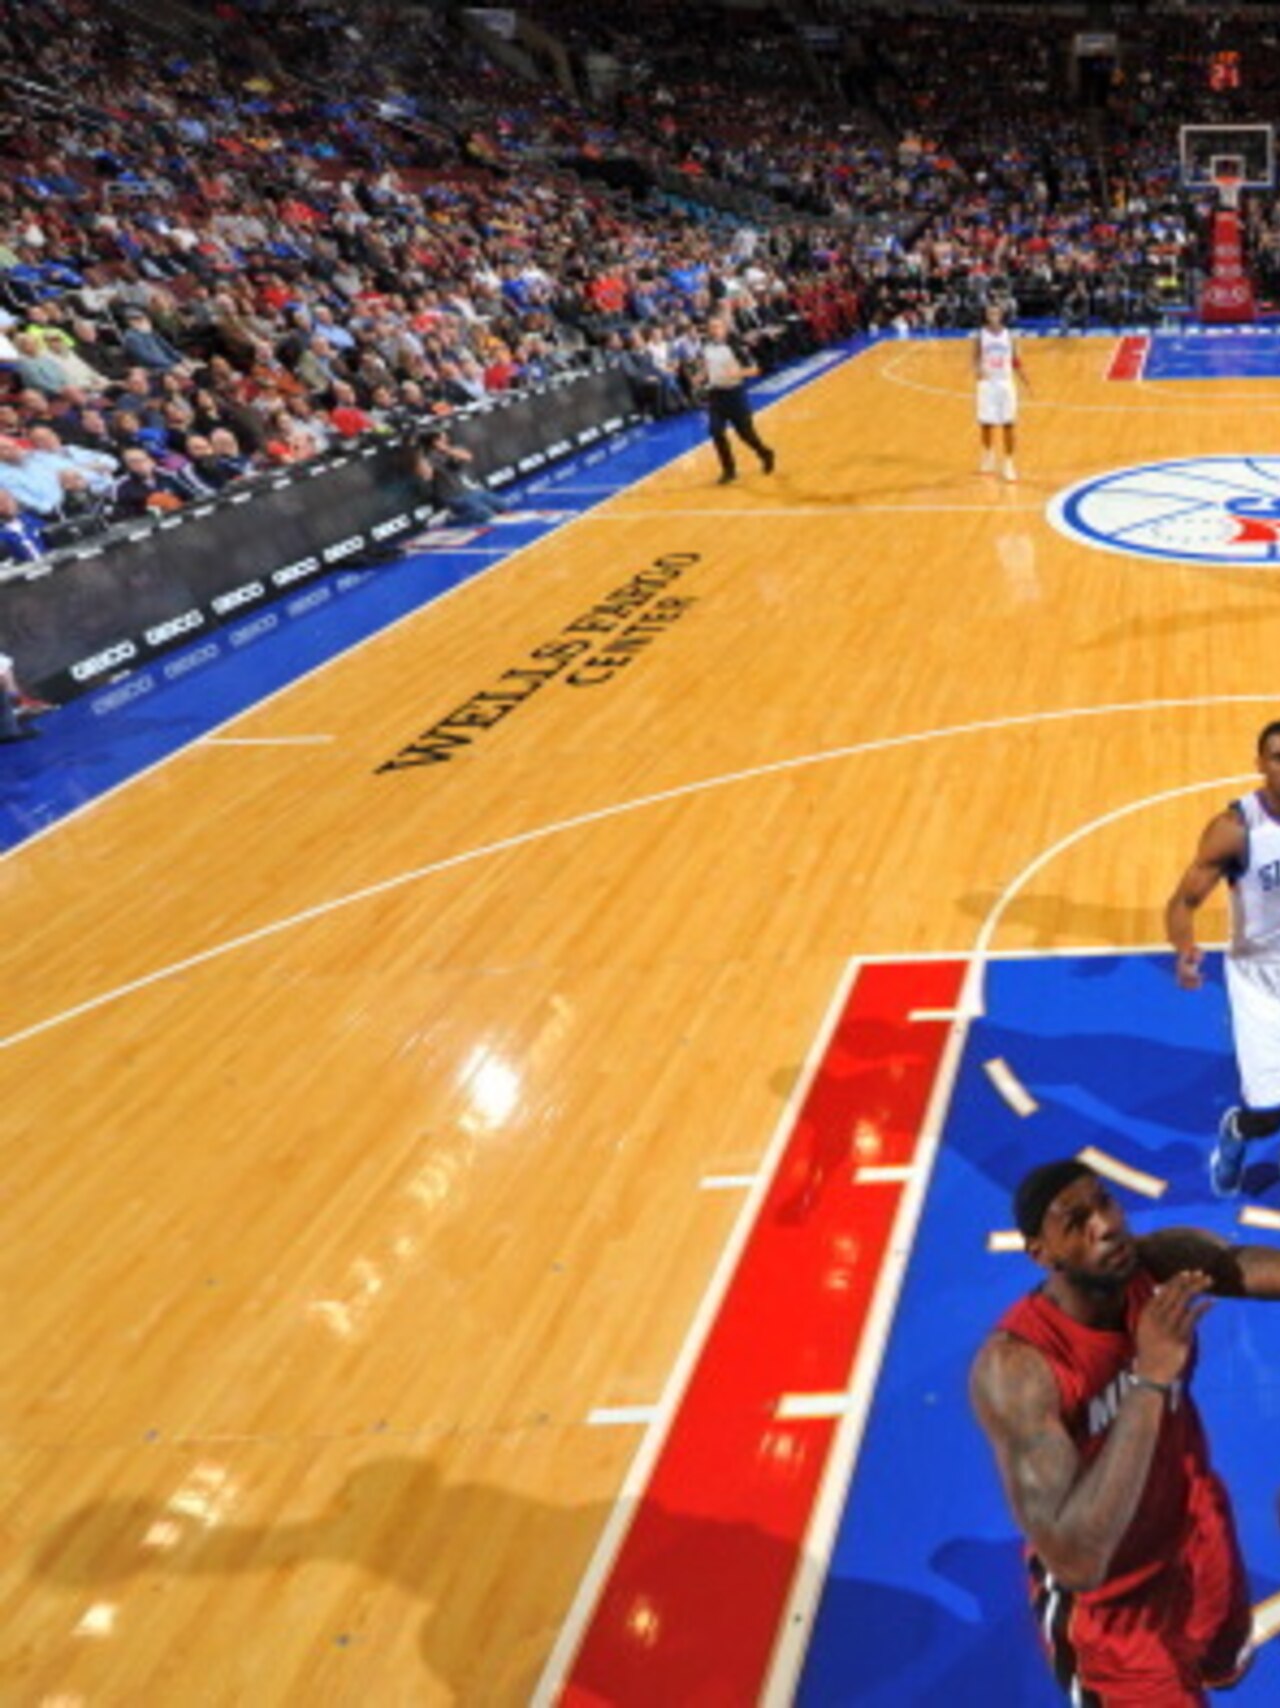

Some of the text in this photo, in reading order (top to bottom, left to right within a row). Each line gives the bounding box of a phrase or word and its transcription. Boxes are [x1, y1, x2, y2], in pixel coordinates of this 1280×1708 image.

[71, 640, 136, 681] GEICO
[145, 608, 204, 646] GEICO
[211, 581, 265, 616] GEICO
[373, 552, 701, 774] WELLS FARGO
[565, 596, 699, 687] CENTER
